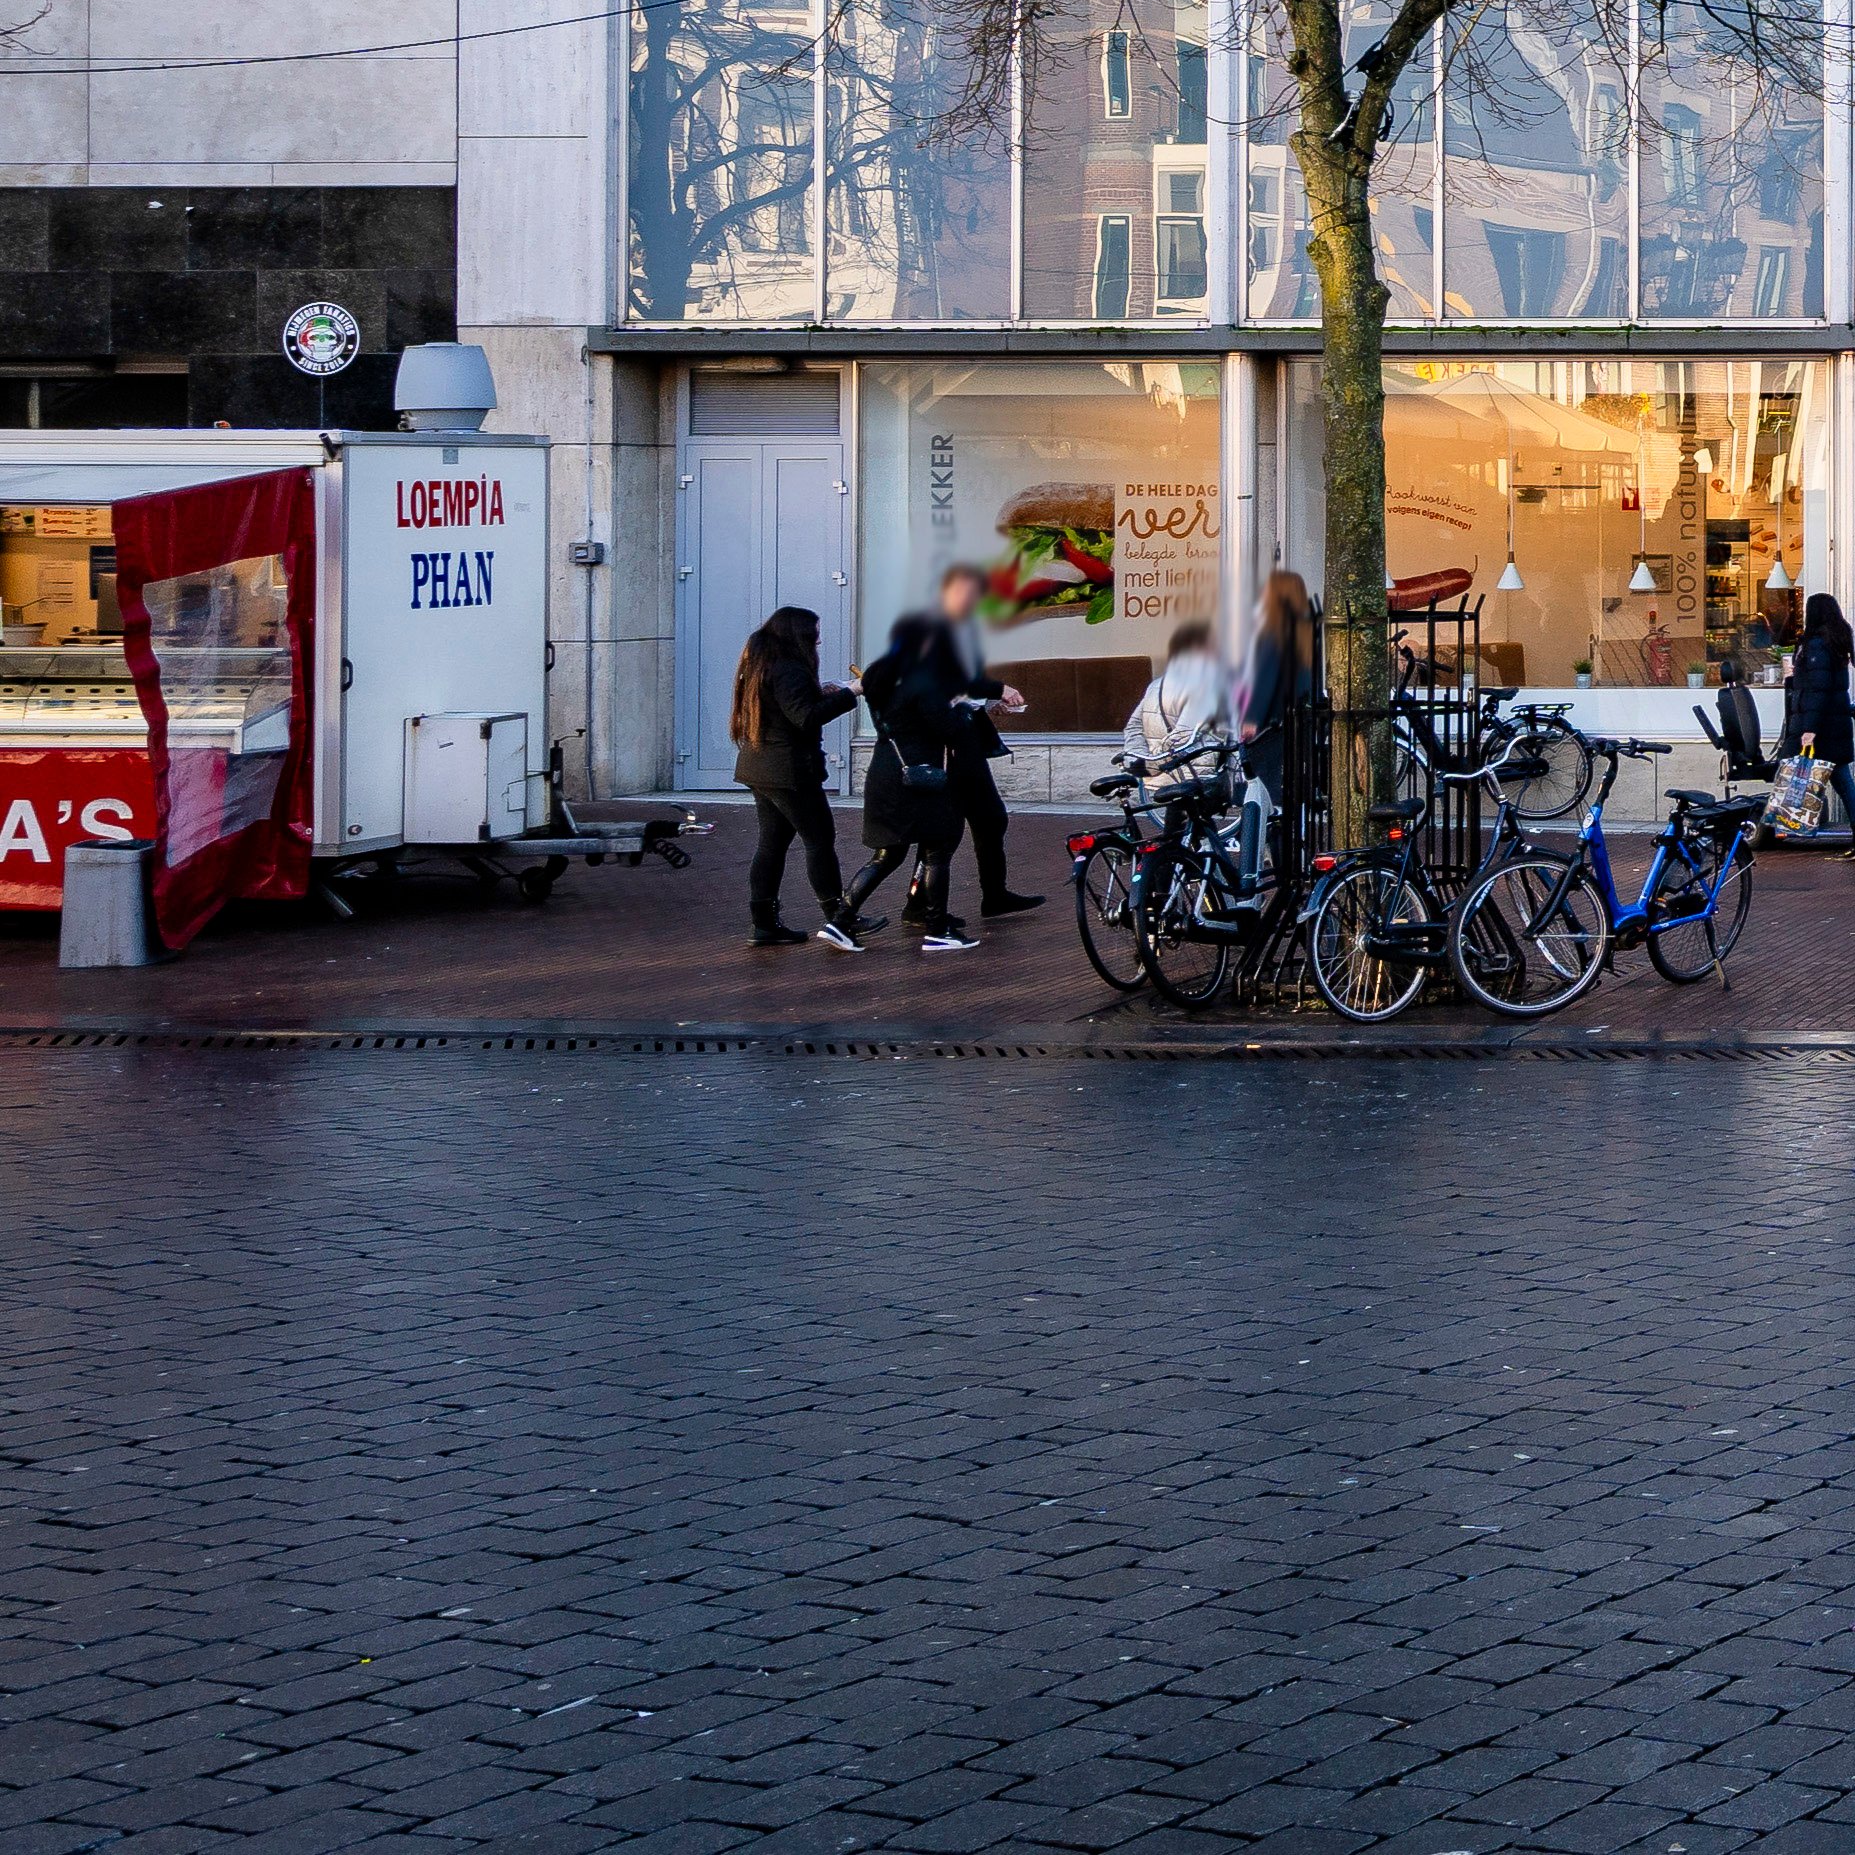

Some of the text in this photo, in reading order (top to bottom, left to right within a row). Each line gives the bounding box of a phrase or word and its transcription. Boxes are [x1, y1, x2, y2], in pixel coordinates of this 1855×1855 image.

[1125, 483, 1218, 497] DE HELE DAG
[1387, 505, 1473, 531] volgens eigen recept
[1123, 542, 1178, 567] belegde
[410, 551, 495, 610] PHAN
[1124, 571, 1161, 588] met
[1676, 551, 1697, 624] 100%
